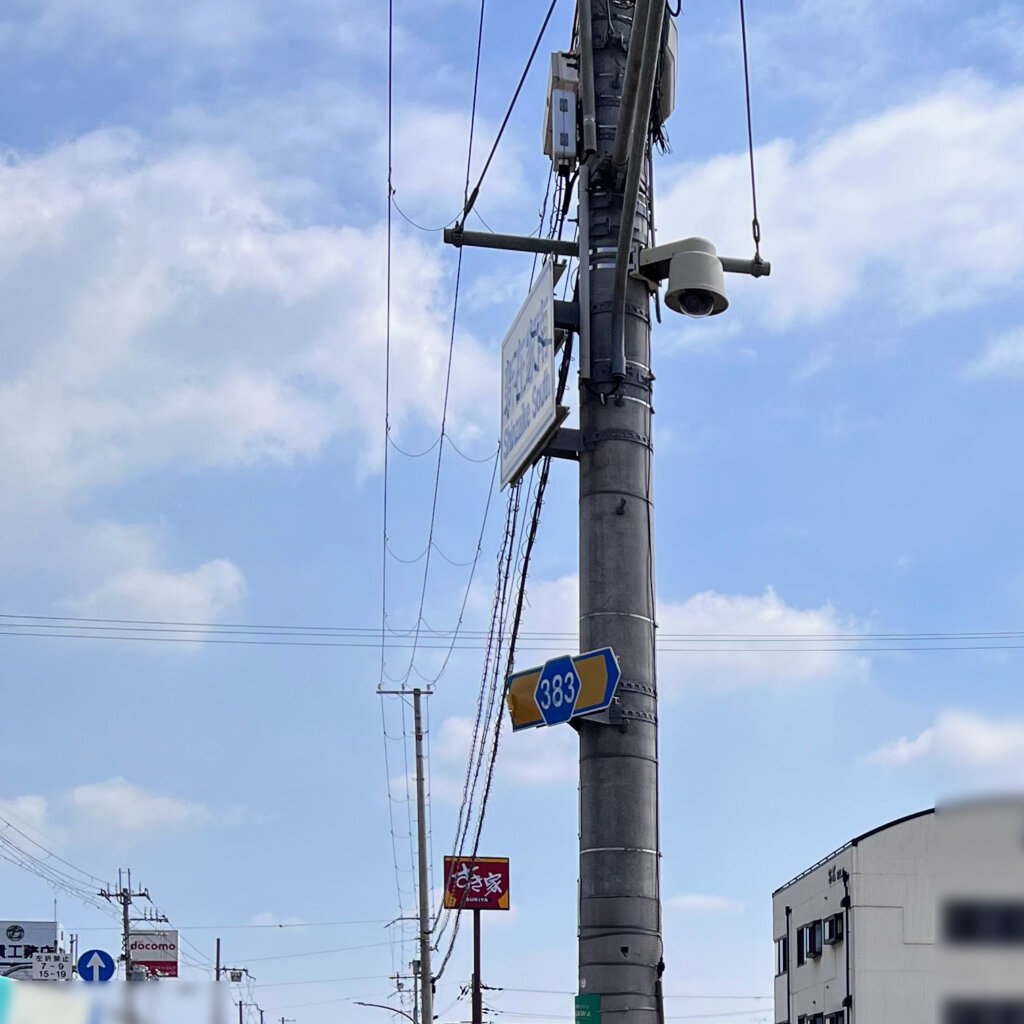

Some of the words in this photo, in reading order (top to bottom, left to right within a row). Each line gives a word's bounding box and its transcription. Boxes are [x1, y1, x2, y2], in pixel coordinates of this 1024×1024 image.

[540, 671, 575, 710] 383
[451, 863, 502, 897] すき家
[130, 940, 176, 951] docomo
[36, 955, 69, 963] 左折禁止
